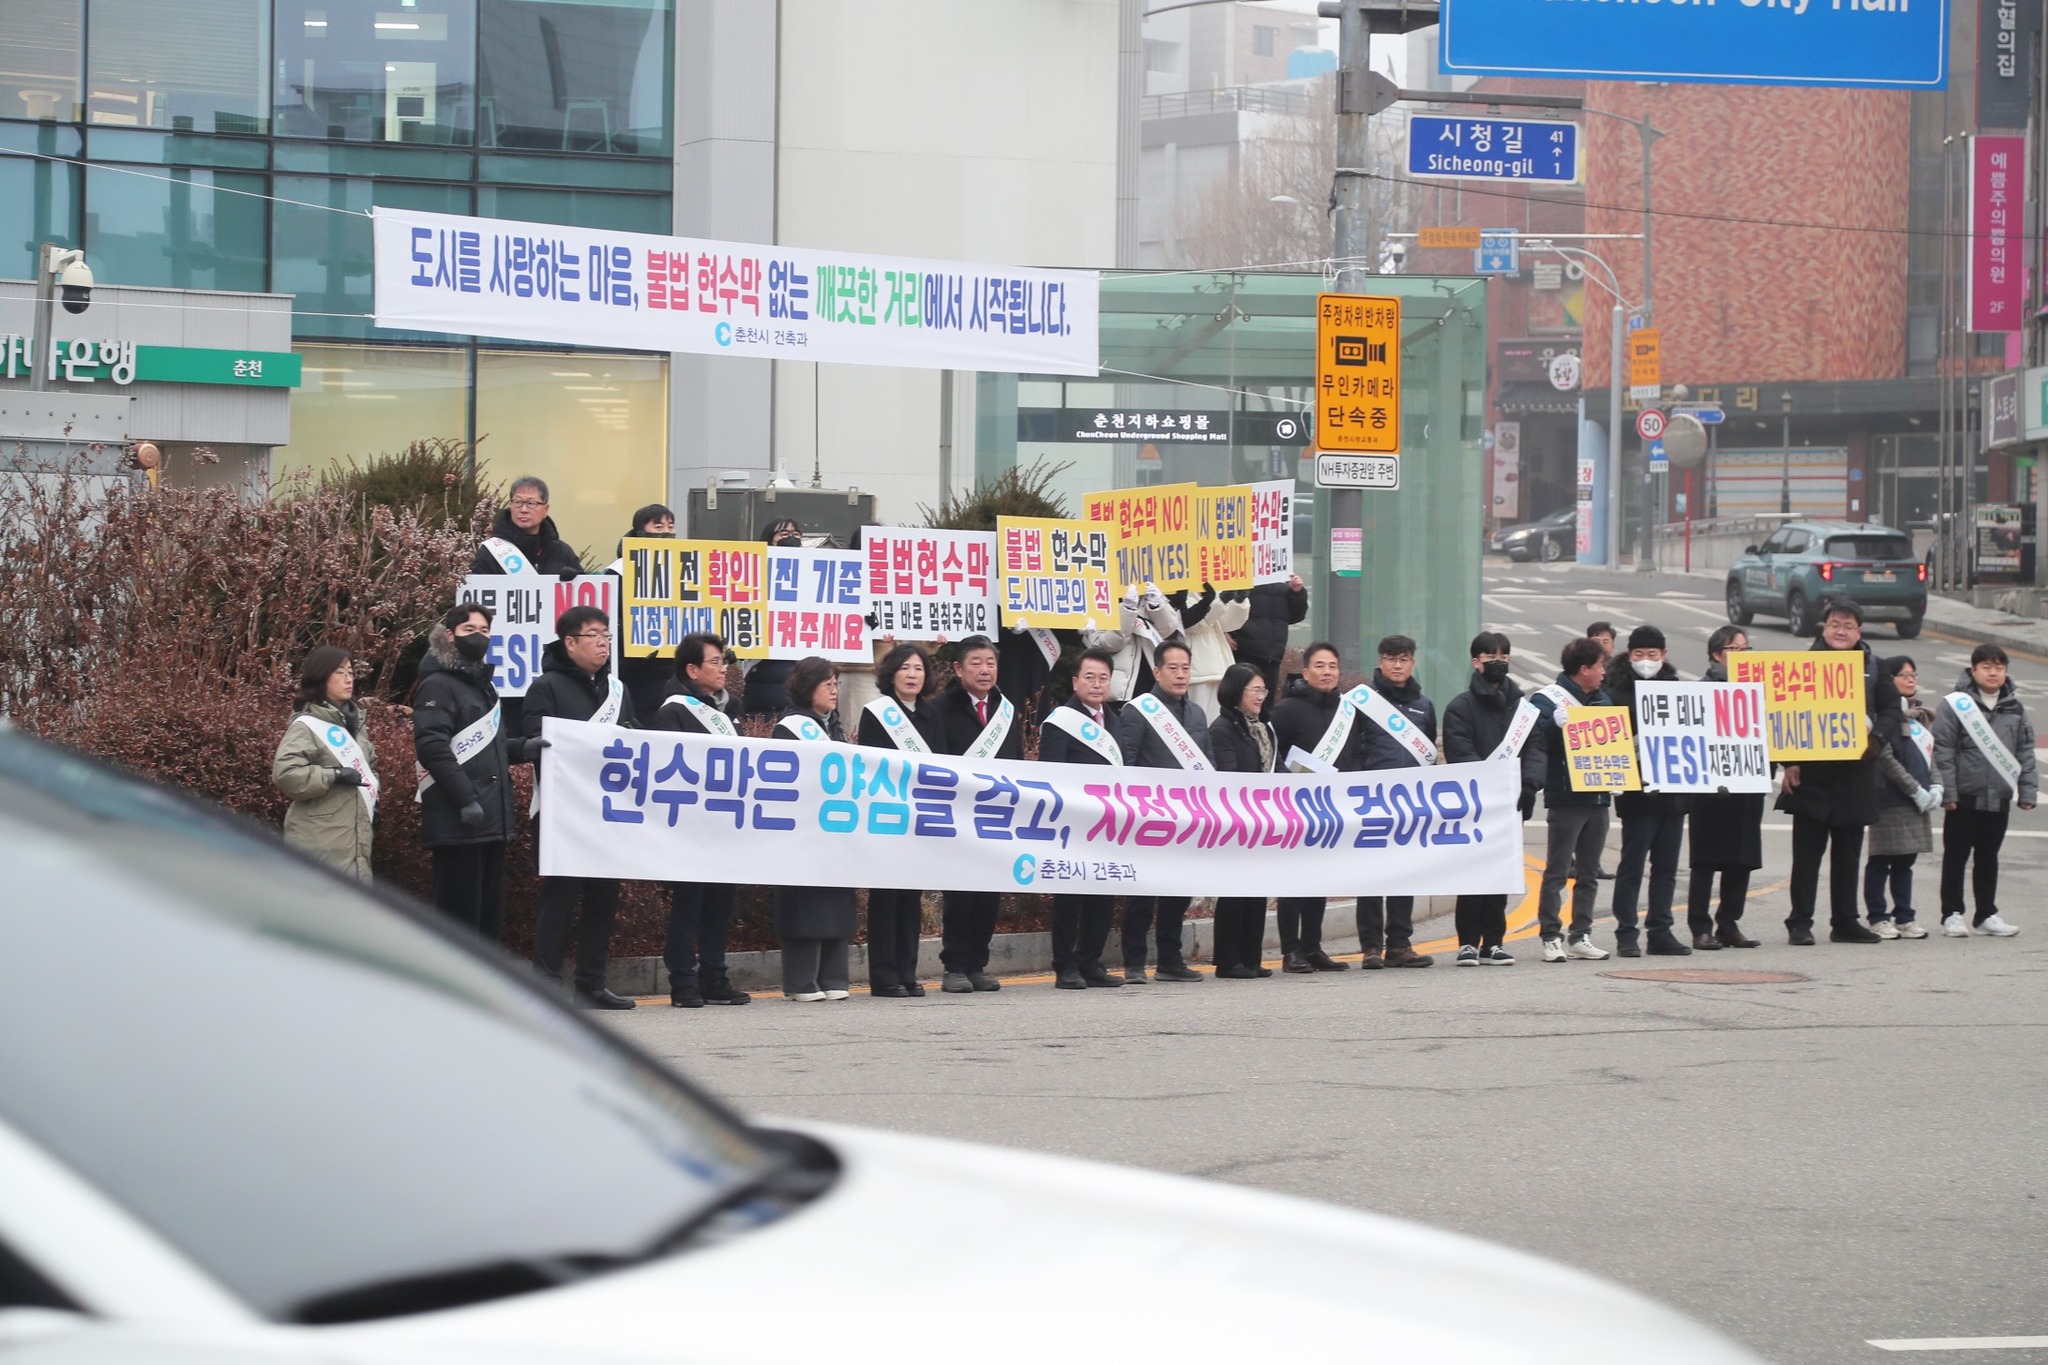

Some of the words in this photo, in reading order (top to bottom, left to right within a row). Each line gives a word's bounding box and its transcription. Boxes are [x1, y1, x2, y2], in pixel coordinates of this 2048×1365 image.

[1439, 124, 1522, 154] 시청길
[1550, 131, 1563, 143] 41
[1428, 154, 1533, 177] Sicheong-gil
[411, 227, 481, 293] 도시를
[490, 234, 580, 302] 사랑하는
[588, 244, 639, 312] 마음,
[647, 249, 690, 311] 불법
[697, 252, 762, 316] 현수막
[769, 259, 809, 320] 없는
[816, 265, 878, 325] 깨끗한
[884, 270, 963, 331] 거리에서
[970, 276, 1071, 337] 시작됩니다.
[1323, 304, 1395, 329] 주정차위반차량
[1989, 301, 2005, 313] 2F
[735, 326, 769, 345] 춘천시
[774, 329, 808, 347] 건축과
[233, 359, 262, 378] 춘천
[1322, 374, 1394, 399] 무인카메라
[1093, 413, 1210, 430] 춘천지하쇼핑몰
[1120, 431, 1171, 440] Underground
[1172, 432, 1208, 441] Shopping
[1328, 406, 1388, 429] 단속중
[1644, 418, 1660, 432] 50
[1321, 462, 1375, 480] NH투자증권앞
[1378, 463, 1394, 480] 주변
[1119, 496, 1157, 539] 현수막
[1163, 495, 1189, 532] NO!
[1196, 497, 1209, 540] 시
[1216, 496, 1246, 540] 방법이
[868, 537, 989, 597] 불법현수막
[1006, 528, 1042, 571] 불법
[1051, 529, 1107, 573] 현수막
[1116, 544, 1153, 586] 게시대
[1157, 543, 1189, 581] YES!
[629, 548, 670, 599] 게시
[680, 550, 699, 601] 전
[709, 549, 760, 602] 확인!
[767, 557, 799, 602] 진
[813, 560, 862, 604] 기준
[506, 589, 542, 624] 데나
[1008, 577, 1087, 614] 도시미관의
[1094, 580, 1111, 614] 적
[720, 607, 760, 647] 이용!
[767, 610, 863, 650] 켜주세요
[900, 601, 923, 630] 바로
[929, 601, 987, 632] 멈춰주세요
[486, 634, 539, 689] ES!
[1772, 661, 1817, 702] 현수막
[1823, 663, 1854, 699] NO!
[1642, 694, 1670, 726] 아무
[1677, 694, 1705, 727] 데나
[1713, 688, 1760, 738] NO!
[1769, 710, 1813, 750] 게시대
[1817, 712, 1856, 749] YES!
[1567, 714, 1628, 751] STOP!
[1574, 755, 1591, 769] 불법
[1593, 755, 1631, 769] 현수막은
[1645, 735, 1709, 785] YES!
[1709, 743, 1766, 777] 지정게시대
[600, 738, 799, 831] 현수막은
[818, 752, 959, 838] 양심을
[972, 772, 1070, 849] 걸고,
[1083, 782, 1344, 849] 지정게시대에
[1347, 778, 1483, 848] 걸어요!
[1584, 772, 1602, 786] 이제
[1040, 859, 1086, 880] 춘천시
[1092, 861, 1137, 882] 건축과
